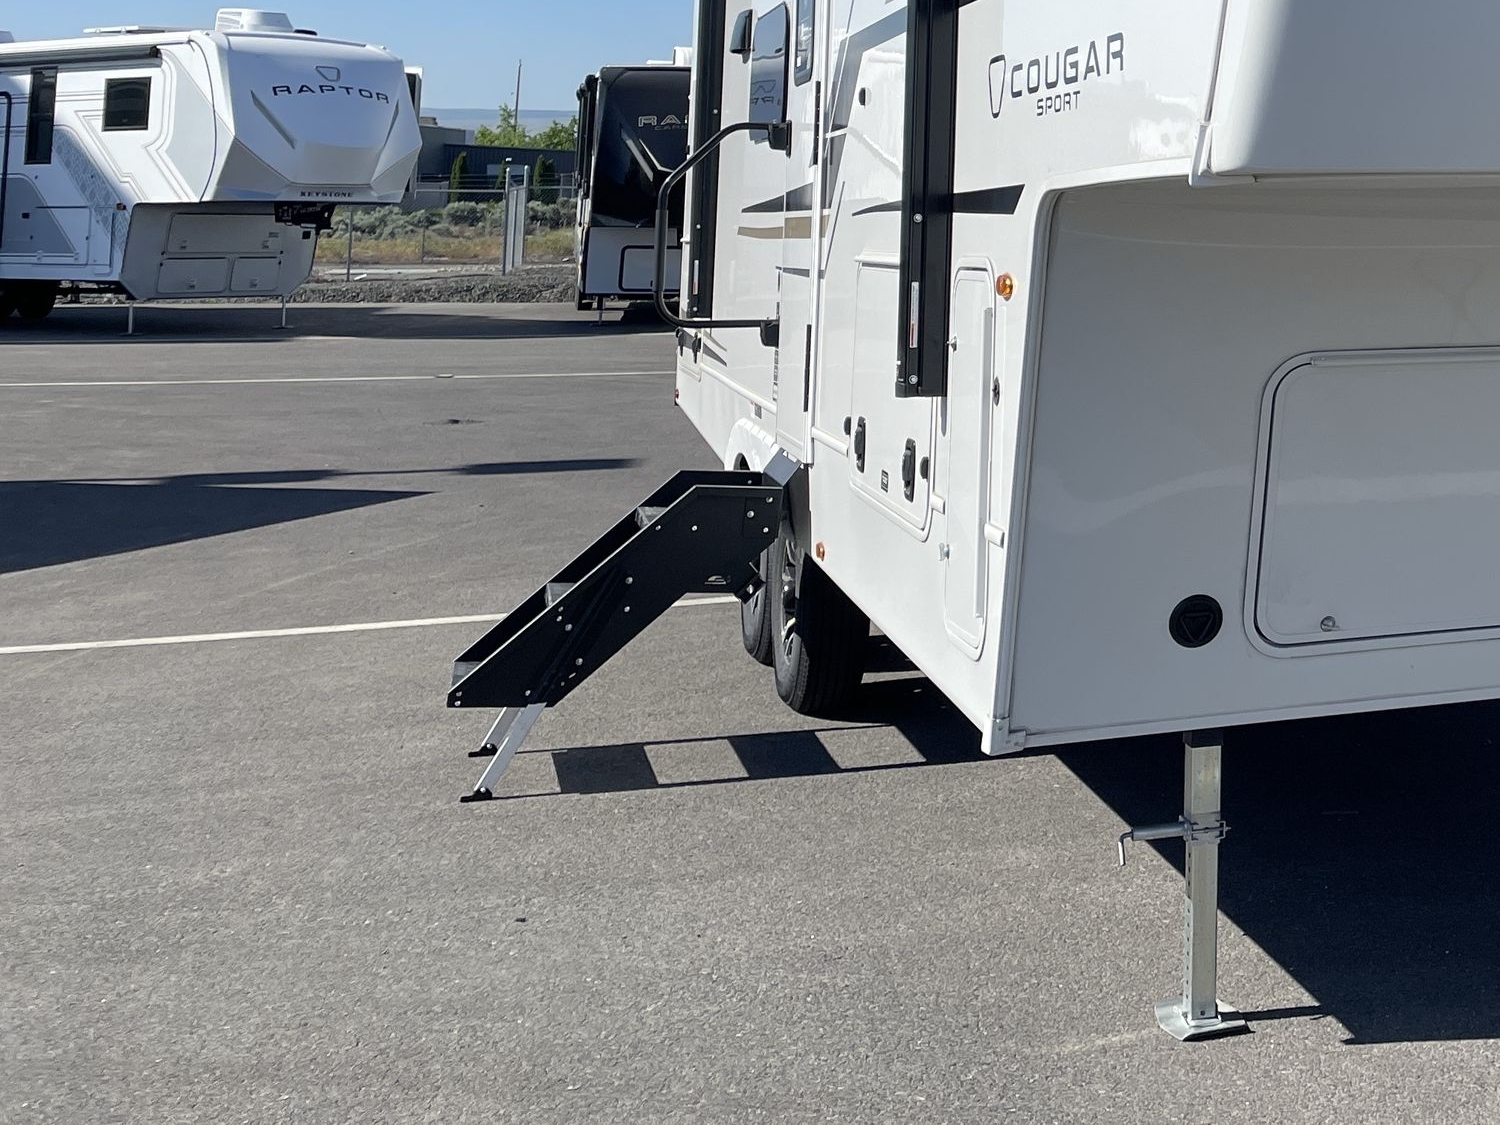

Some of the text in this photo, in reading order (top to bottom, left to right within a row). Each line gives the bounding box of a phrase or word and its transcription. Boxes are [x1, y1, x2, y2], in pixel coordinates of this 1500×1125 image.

[1010, 31, 1124, 99] COUGAR
[271, 84, 390, 104] RAPTOR
[1036, 90, 1081, 116] SPORT
[638, 114, 688, 127] RA
